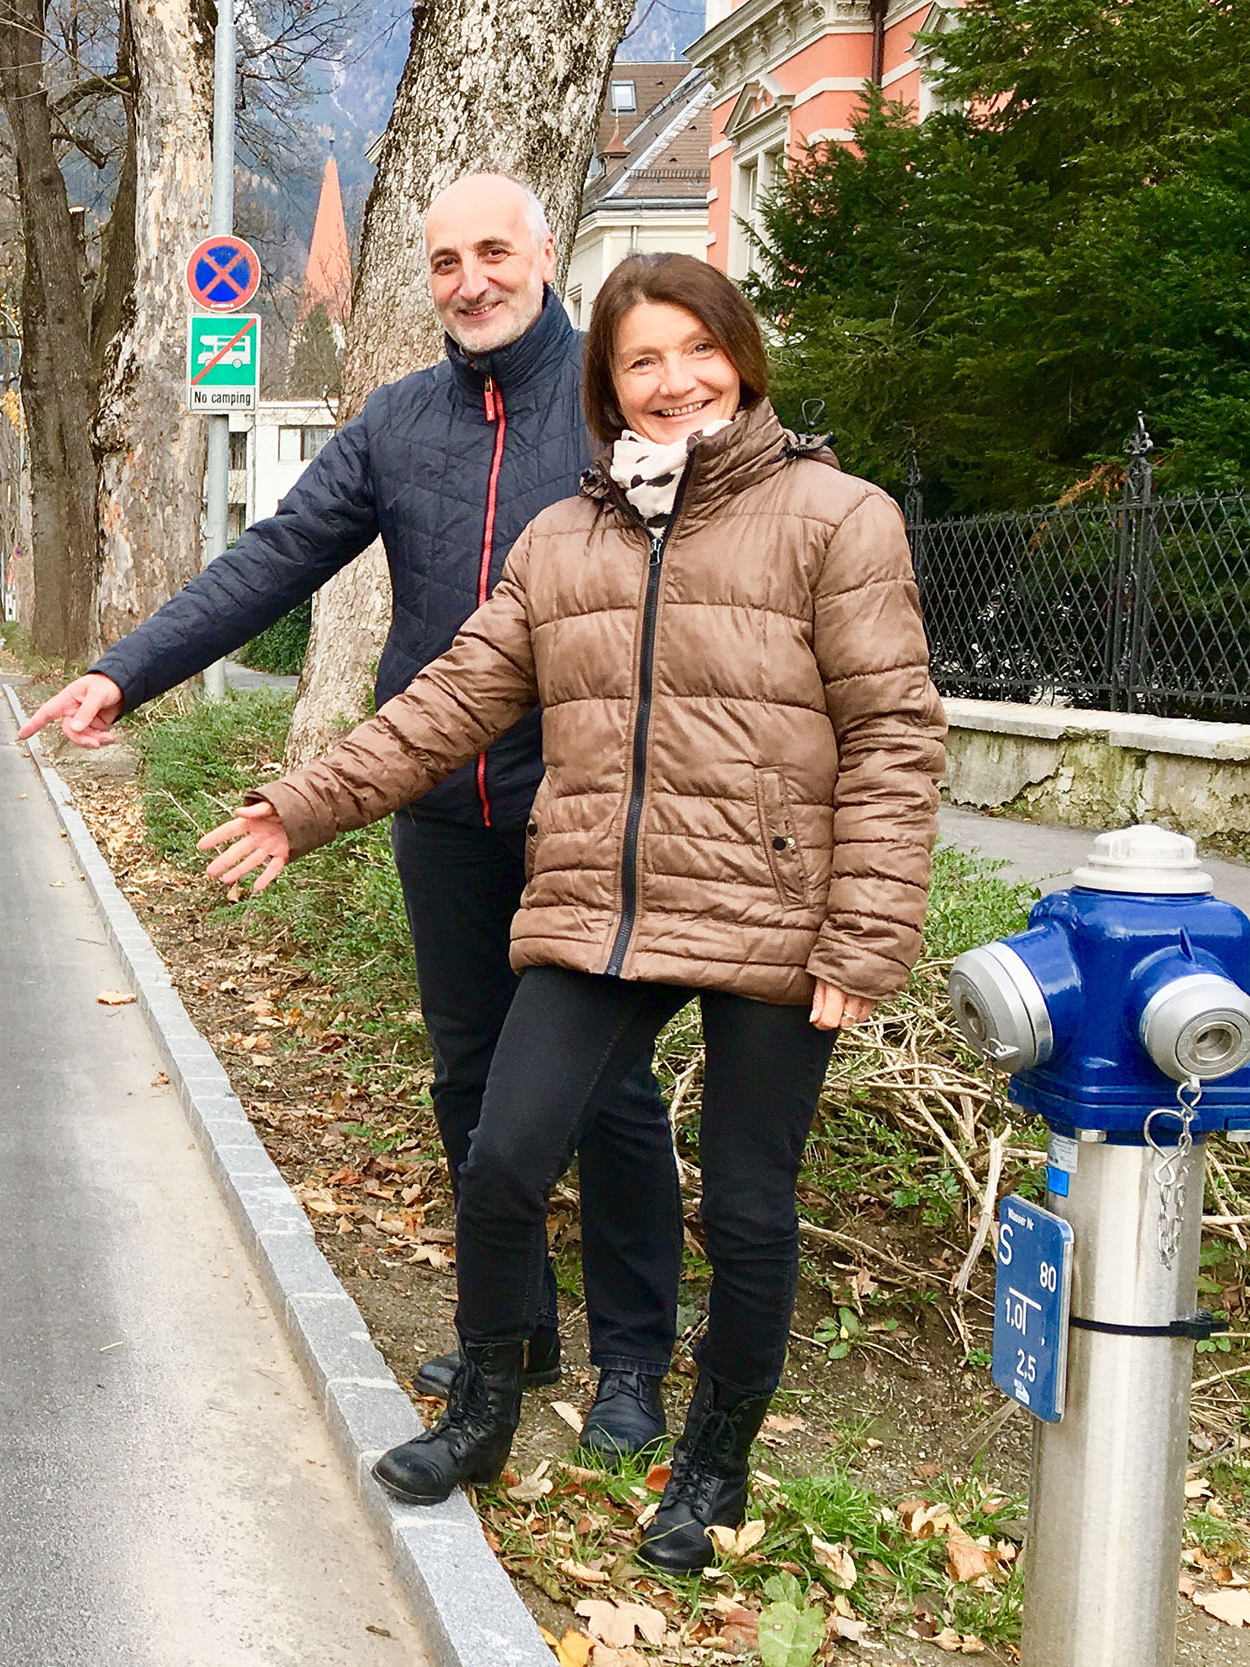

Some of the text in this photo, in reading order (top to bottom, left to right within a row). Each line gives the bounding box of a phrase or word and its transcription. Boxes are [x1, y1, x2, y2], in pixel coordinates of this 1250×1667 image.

[194, 391, 251, 406] No camping
[999, 1223, 1014, 1266] S
[1039, 1261, 1057, 1293] 80
[1016, 1348, 1037, 1383] 2,5
